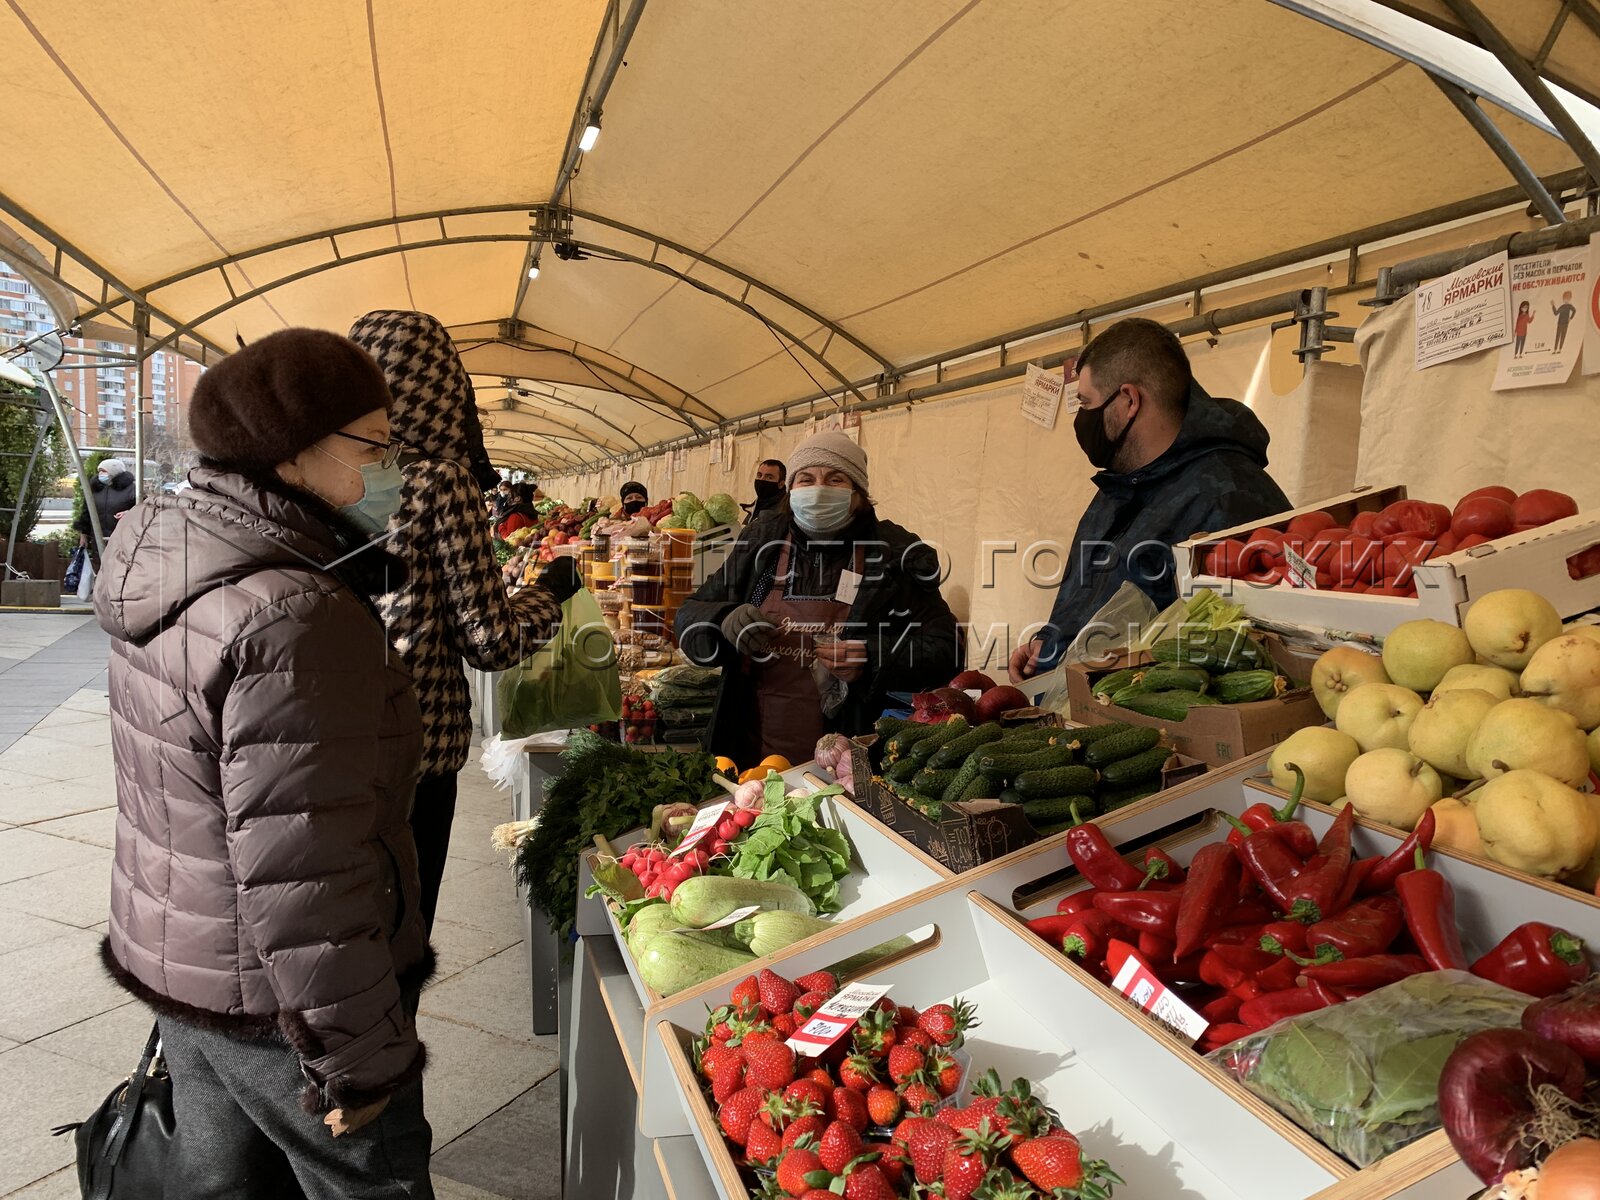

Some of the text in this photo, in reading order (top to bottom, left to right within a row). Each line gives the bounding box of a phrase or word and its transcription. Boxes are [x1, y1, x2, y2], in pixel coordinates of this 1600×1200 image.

[1513, 259, 1551, 272] ПОСЕТИТЕЛИ
[1526, 268, 1546, 278] МАСОК
[1547, 267, 1552, 275] И
[1552, 261, 1583, 274] ПЕРЧАТОК
[1447, 262, 1504, 292] Московские
[1512, 272, 1586, 292] НЕ ОБСЛУЖИВАЮТСЯ
[1443, 272, 1503, 306] ЯРМАРКИ
[1035, 379, 1060, 396] ЯРМАРКИ
